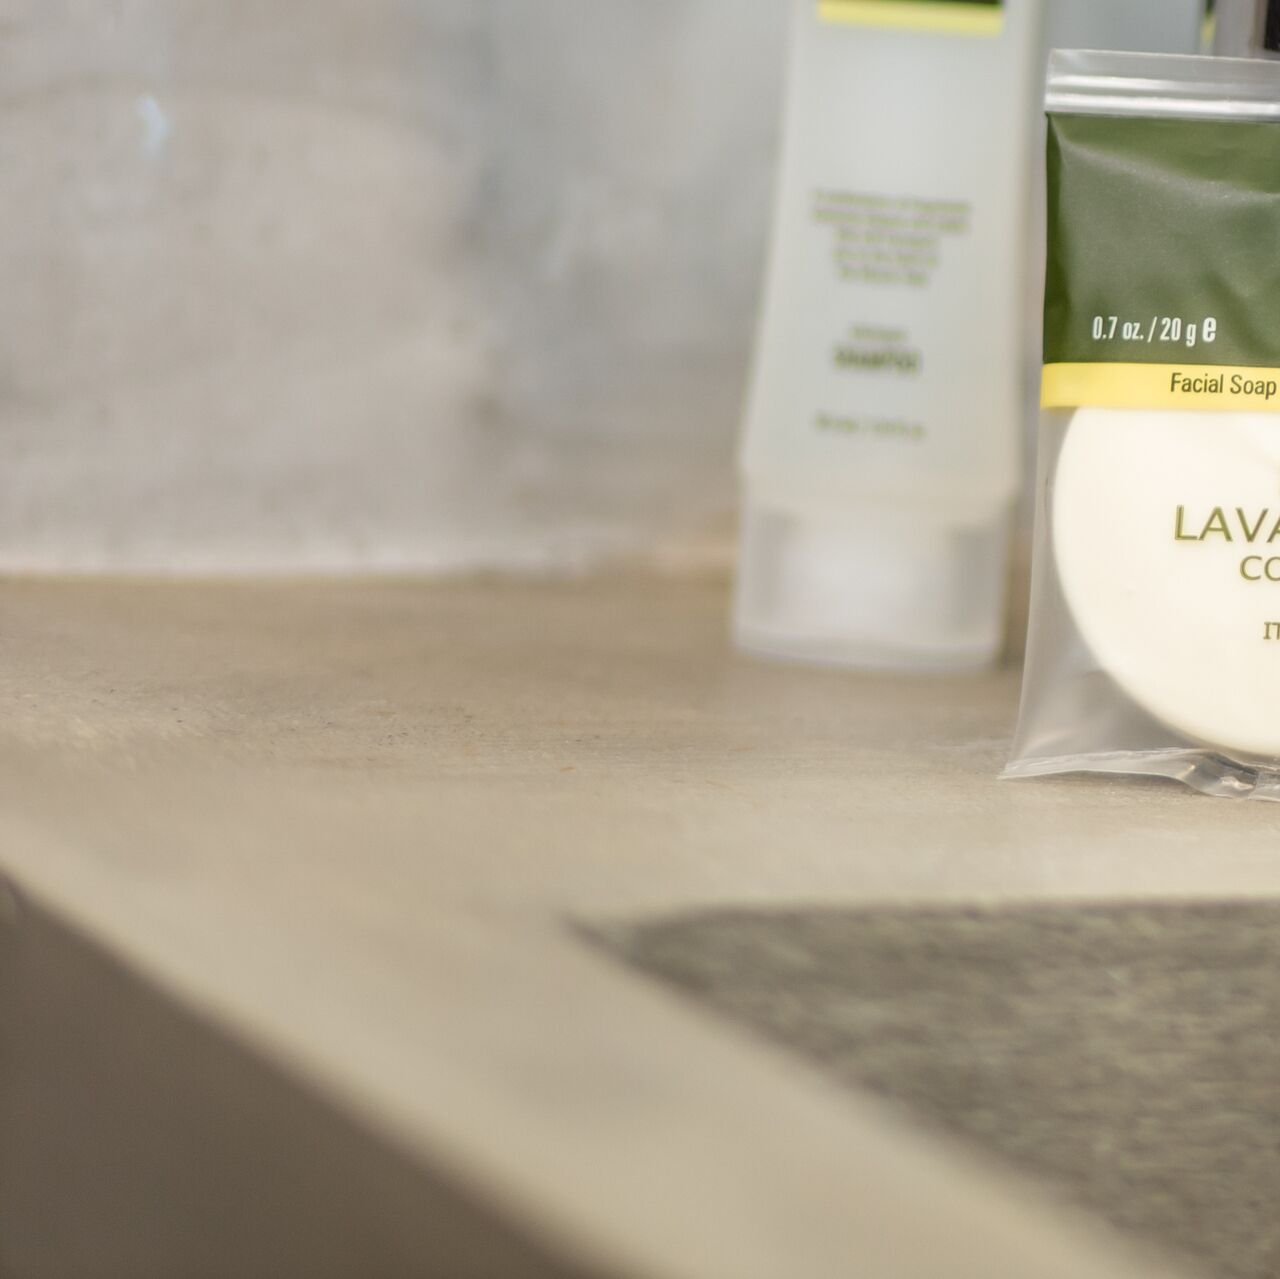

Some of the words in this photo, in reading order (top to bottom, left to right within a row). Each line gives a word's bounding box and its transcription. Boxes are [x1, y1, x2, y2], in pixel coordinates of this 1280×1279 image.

[1092, 316, 1118, 340] 0.7
[1122, 321, 1144, 340] oz.
[1160, 317, 1182, 341] 20
[1186, 323, 1197, 347] g
[1170, 373, 1223, 394] Facial
[1230, 374, 1277, 400] Soap
